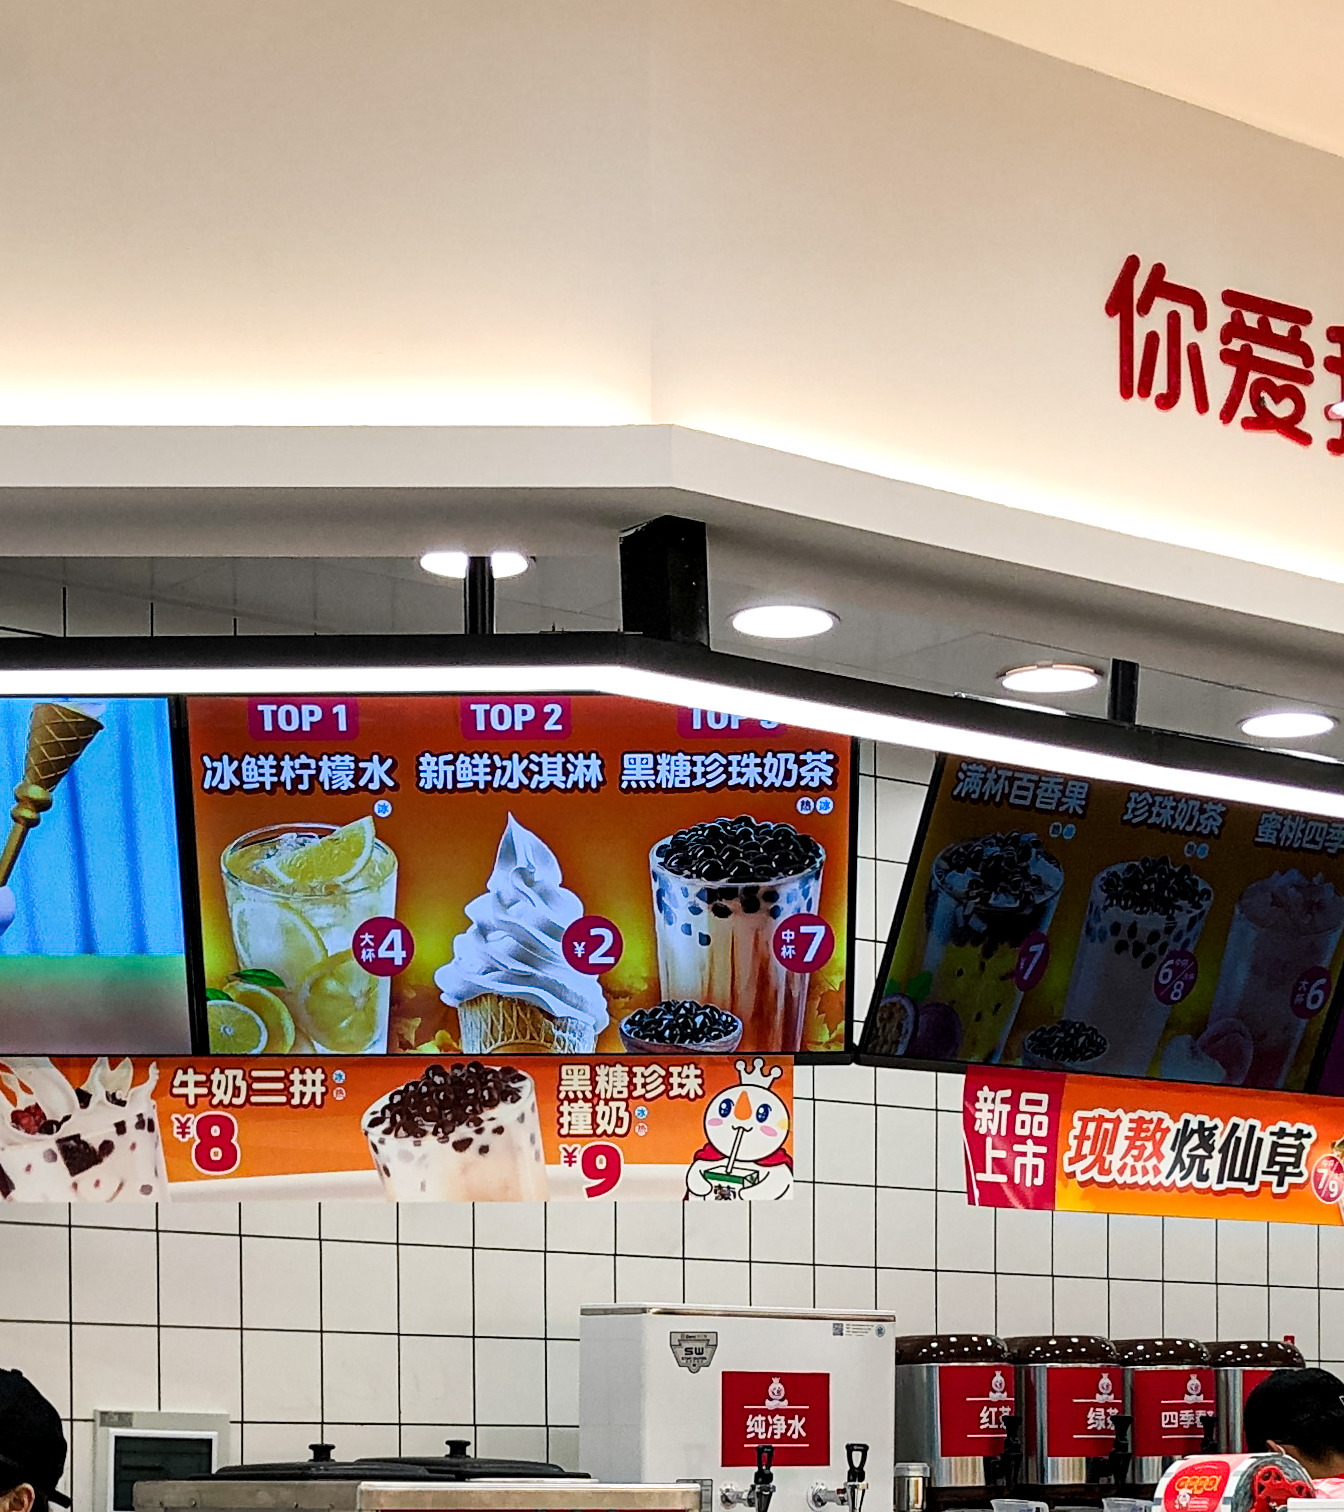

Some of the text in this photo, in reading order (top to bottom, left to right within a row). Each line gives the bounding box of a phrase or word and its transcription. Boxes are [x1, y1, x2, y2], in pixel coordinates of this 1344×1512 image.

[257, 703, 350, 733] TOP 1
[469, 703, 564, 732] TOP 2
[202, 753, 395, 792] 冰鲜柠檬水
[418, 752, 604, 791] 新鲜冰淇淋
[620, 751, 835, 790] 黑糖珍珠奶茶
[953, 762, 1090, 817] 满杯百香果
[1122, 791, 1228, 836] 珍珠奶茶
[359, 928, 407, 966] 大杯 4
[573, 926, 614, 963] ¥2
[780, 924, 826, 963] 中杯 7
[1305, 977, 1326, 1011] 6
[170, 1068, 327, 1108] 牛奶三拼
[557, 1064, 704, 1101] 黑糖珍珠
[558, 1101, 632, 1138] 撞奶
[974, 1085, 1050, 1139] 新品
[975, 1138, 1048, 1188] 上市
[1064, 1107, 1314, 1192] 现熬烧仙草
[684, 1346, 704, 1356] SW
[745, 1413, 807, 1440] 纯净水
